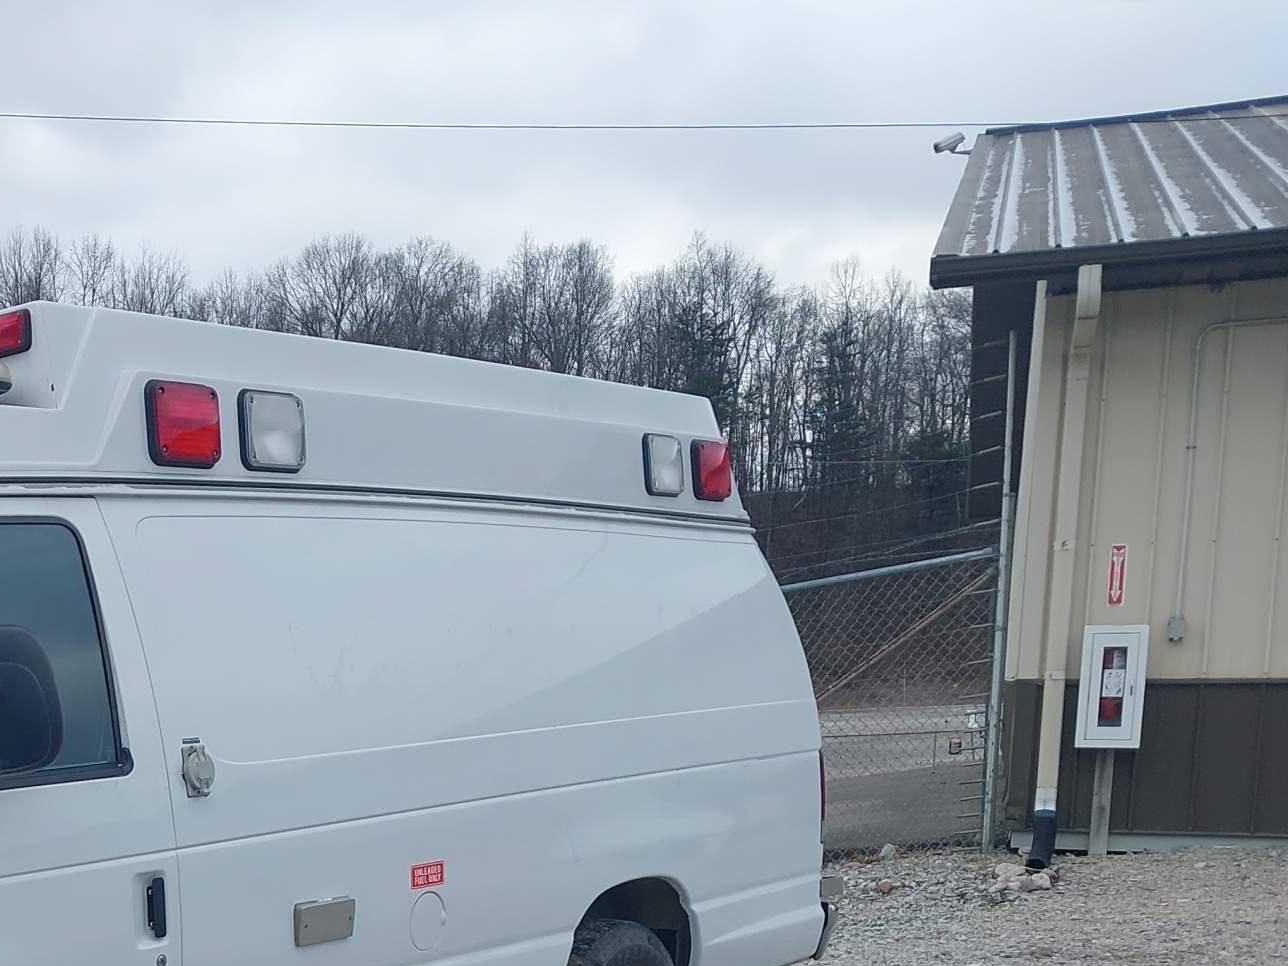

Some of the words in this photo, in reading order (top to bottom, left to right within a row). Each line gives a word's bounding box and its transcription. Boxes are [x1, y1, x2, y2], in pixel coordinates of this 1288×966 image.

[414, 864, 442, 877] UNLEADED
[414, 875, 427, 886] FUEL
[428, 873, 441, 882] ONLY
